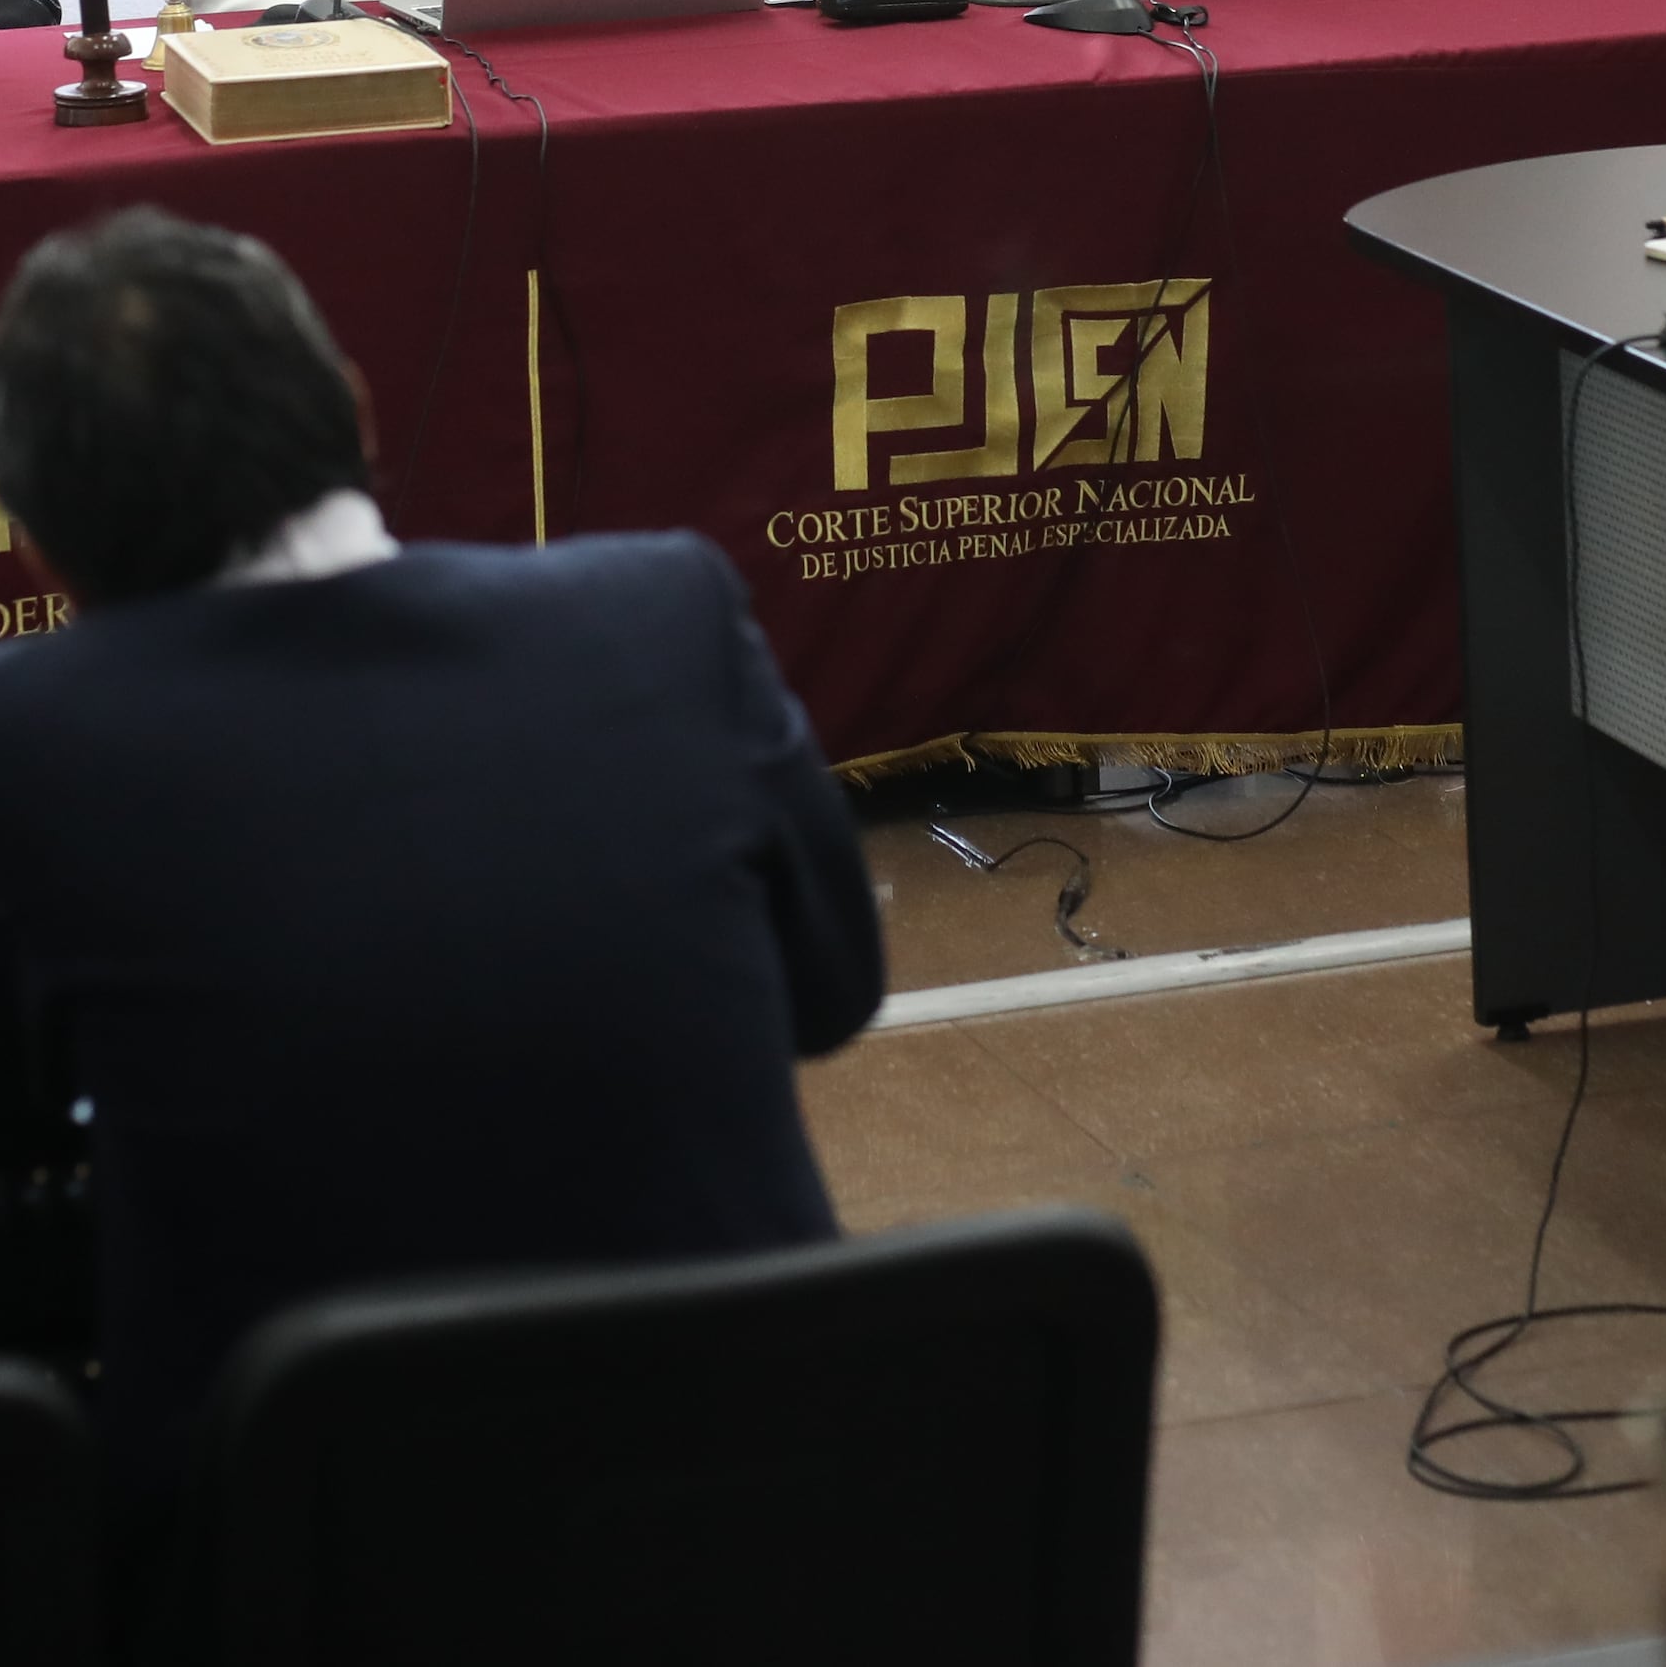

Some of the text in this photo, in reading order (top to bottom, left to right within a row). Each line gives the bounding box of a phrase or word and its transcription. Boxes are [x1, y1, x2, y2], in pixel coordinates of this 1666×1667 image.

[767, 474, 1256, 548] CORTE SUPERIOR NACIONAL
[801, 552, 838, 580] DE
[843, 539, 954, 581] JUSTICIA
[958, 529, 1036, 560] PENAL
